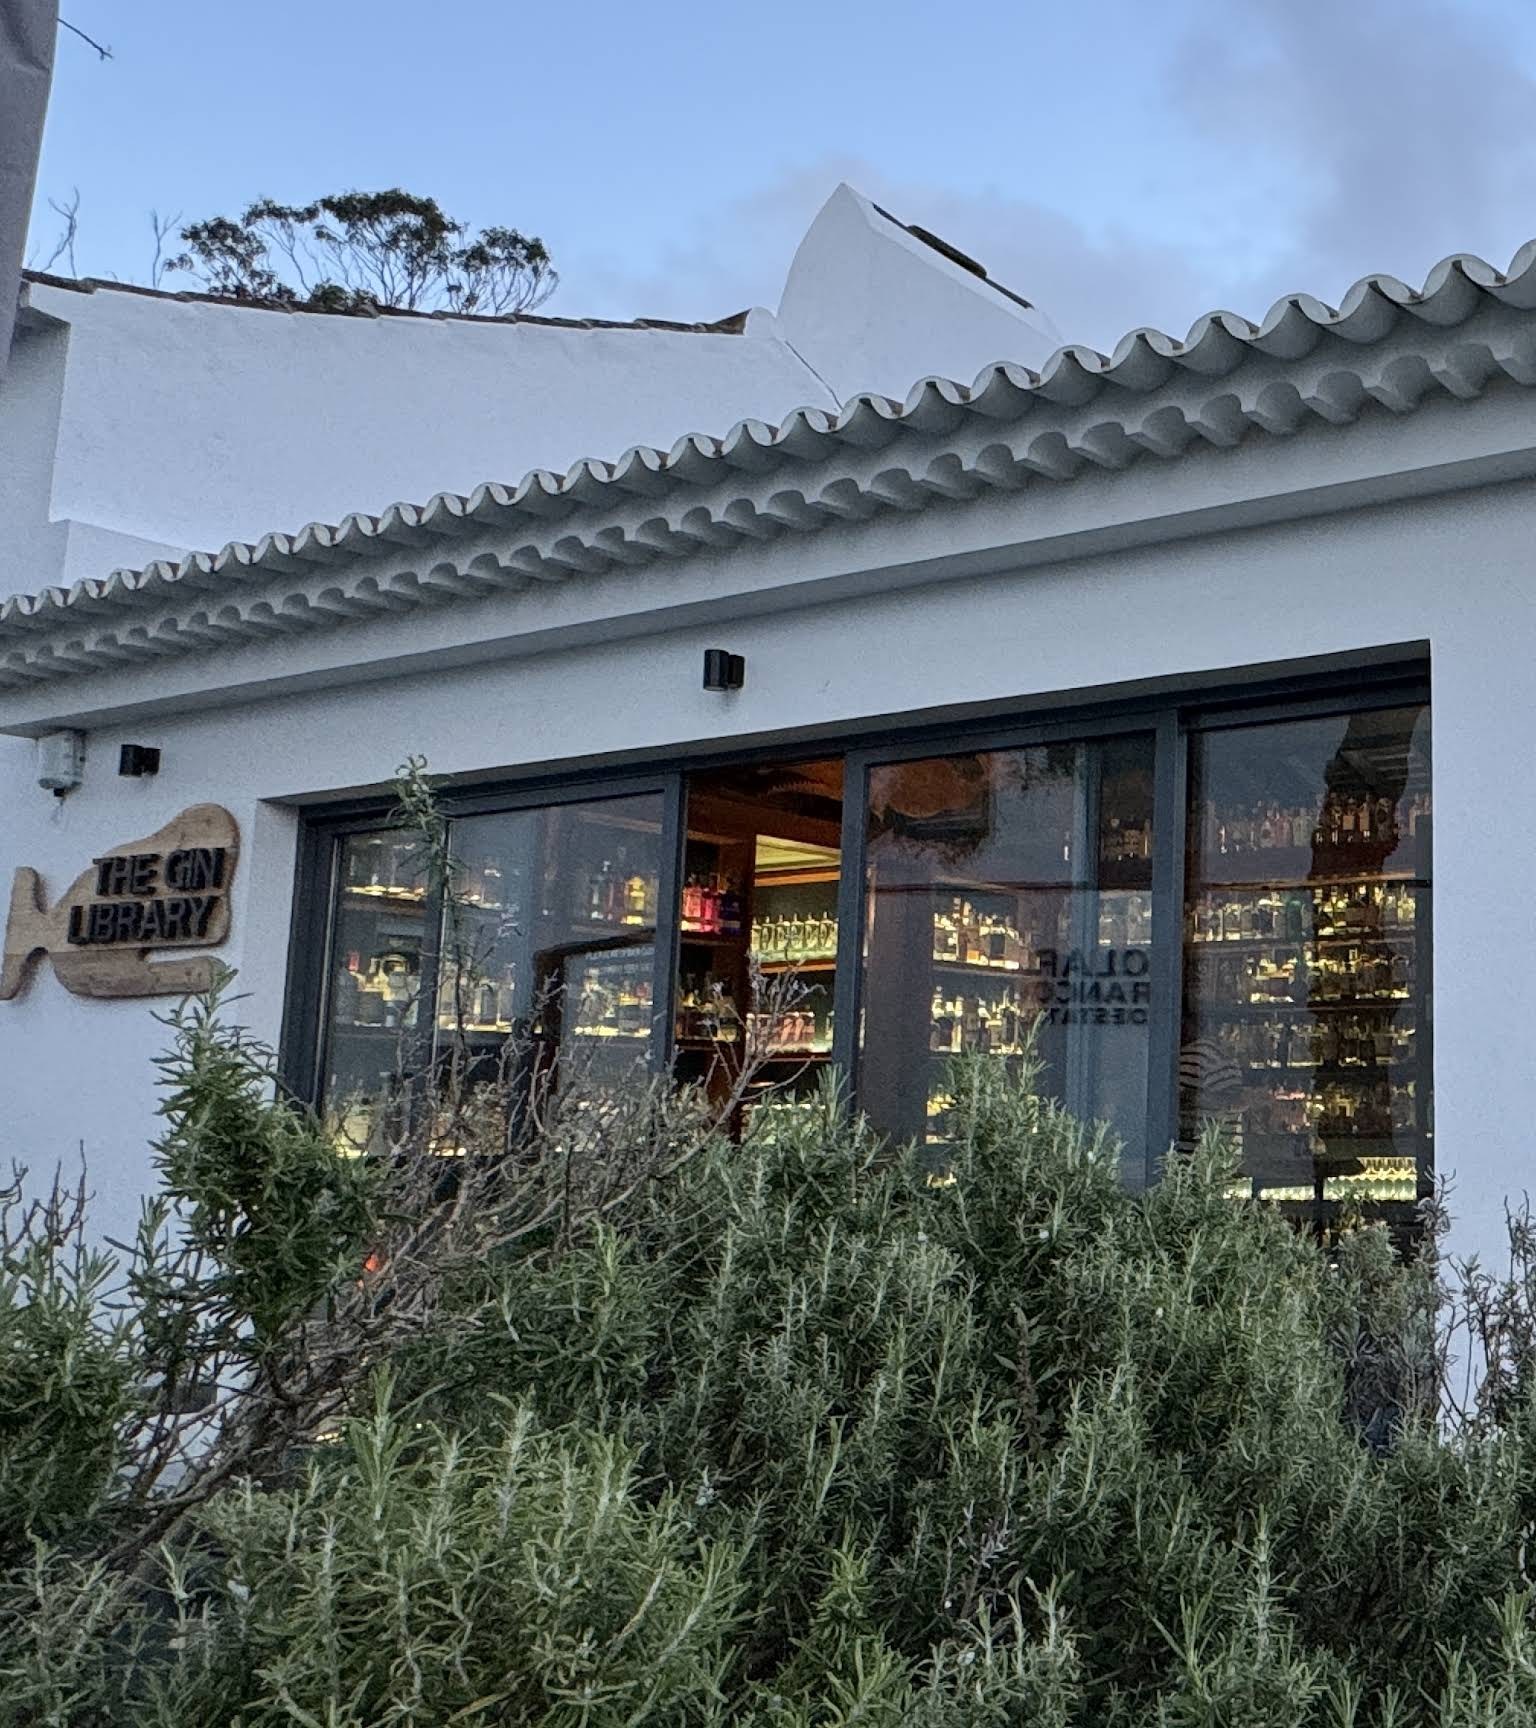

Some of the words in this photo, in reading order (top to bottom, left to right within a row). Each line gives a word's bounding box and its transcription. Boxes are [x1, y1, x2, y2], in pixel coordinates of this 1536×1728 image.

[92, 853, 163, 896] THE
[165, 847, 227, 892] GIN
[67, 895, 221, 945] LIBRARY
